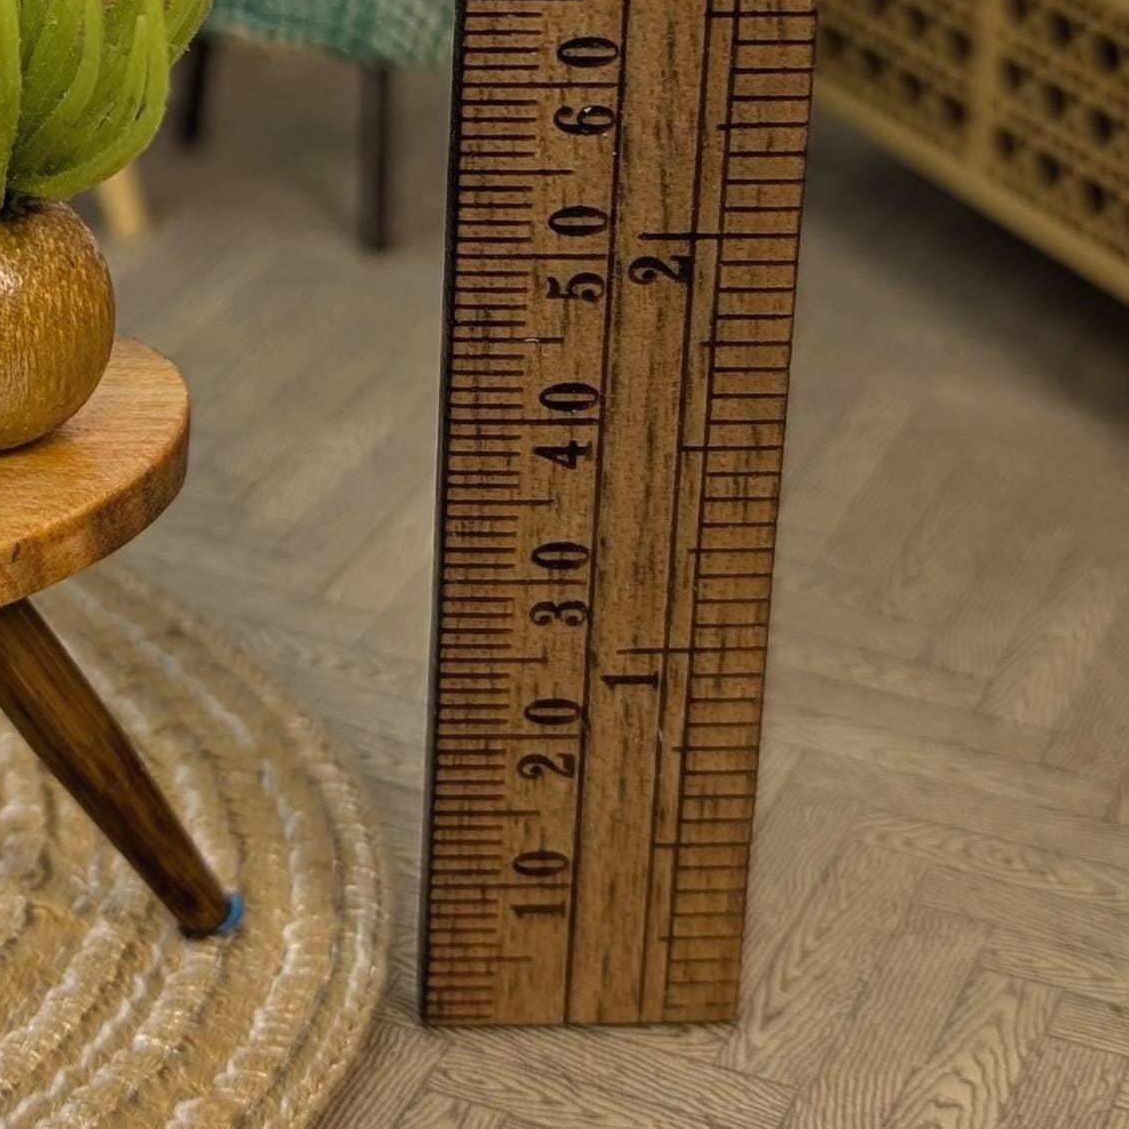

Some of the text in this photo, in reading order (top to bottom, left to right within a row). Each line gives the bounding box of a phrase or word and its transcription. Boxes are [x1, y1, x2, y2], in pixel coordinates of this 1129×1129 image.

[554, 36, 620, 136] 60
[545, 205, 609, 303] 50
[627, 255, 693, 285] 2
[533, 382, 600, 470] 40
[529, 542, 590, 627] 30
[600, 671, 659, 688] 1
[517, 698, 582, 780] 20
[510, 850, 570, 917] 10
